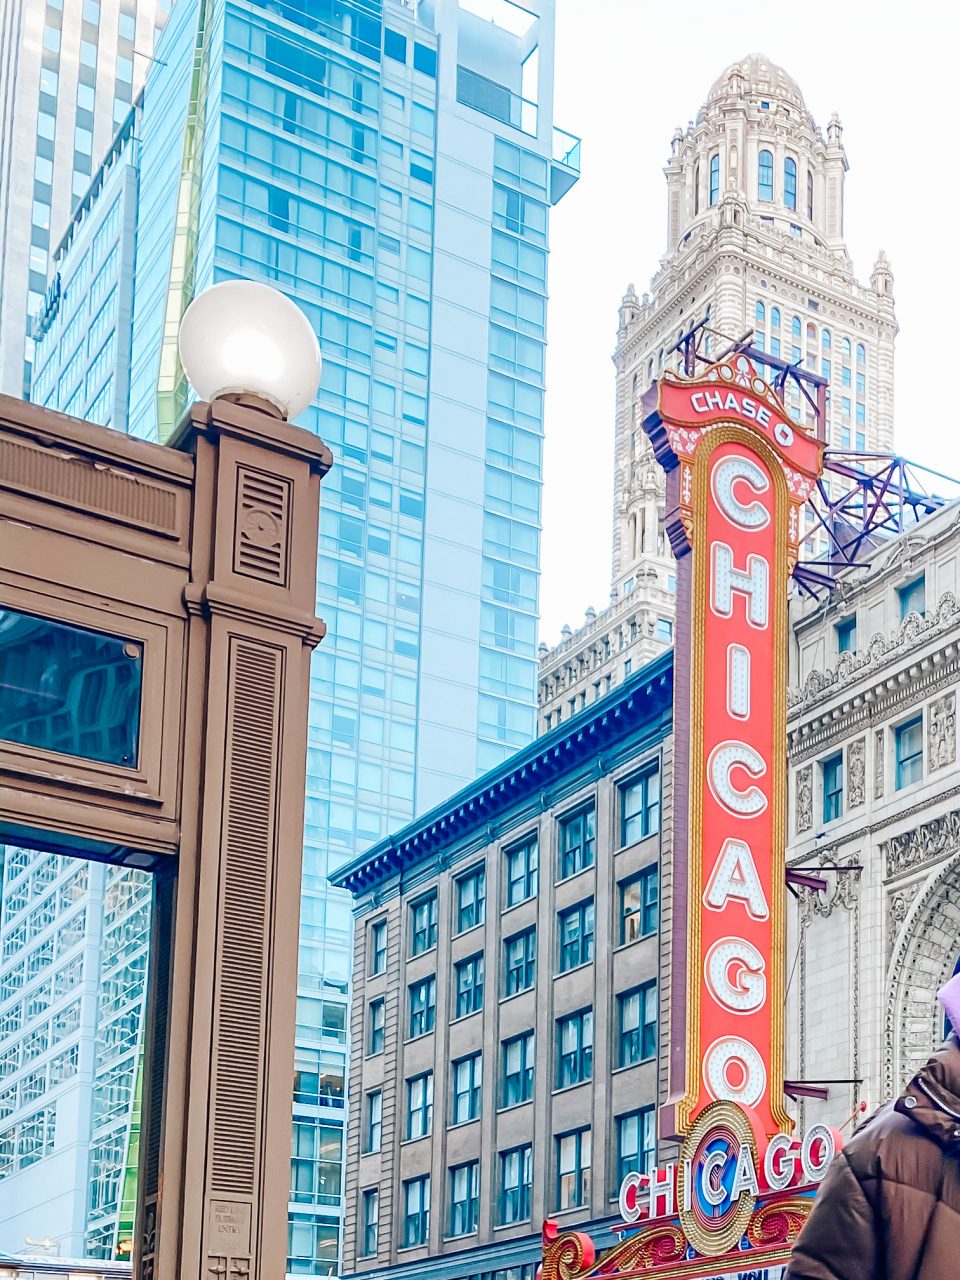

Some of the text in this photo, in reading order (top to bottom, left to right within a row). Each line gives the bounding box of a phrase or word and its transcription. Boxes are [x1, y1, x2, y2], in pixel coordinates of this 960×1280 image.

[690, 390, 773, 430] CHASE
[702, 453, 772, 1109] CHICAGO
[618, 1122, 836, 1223] CHICAGO
